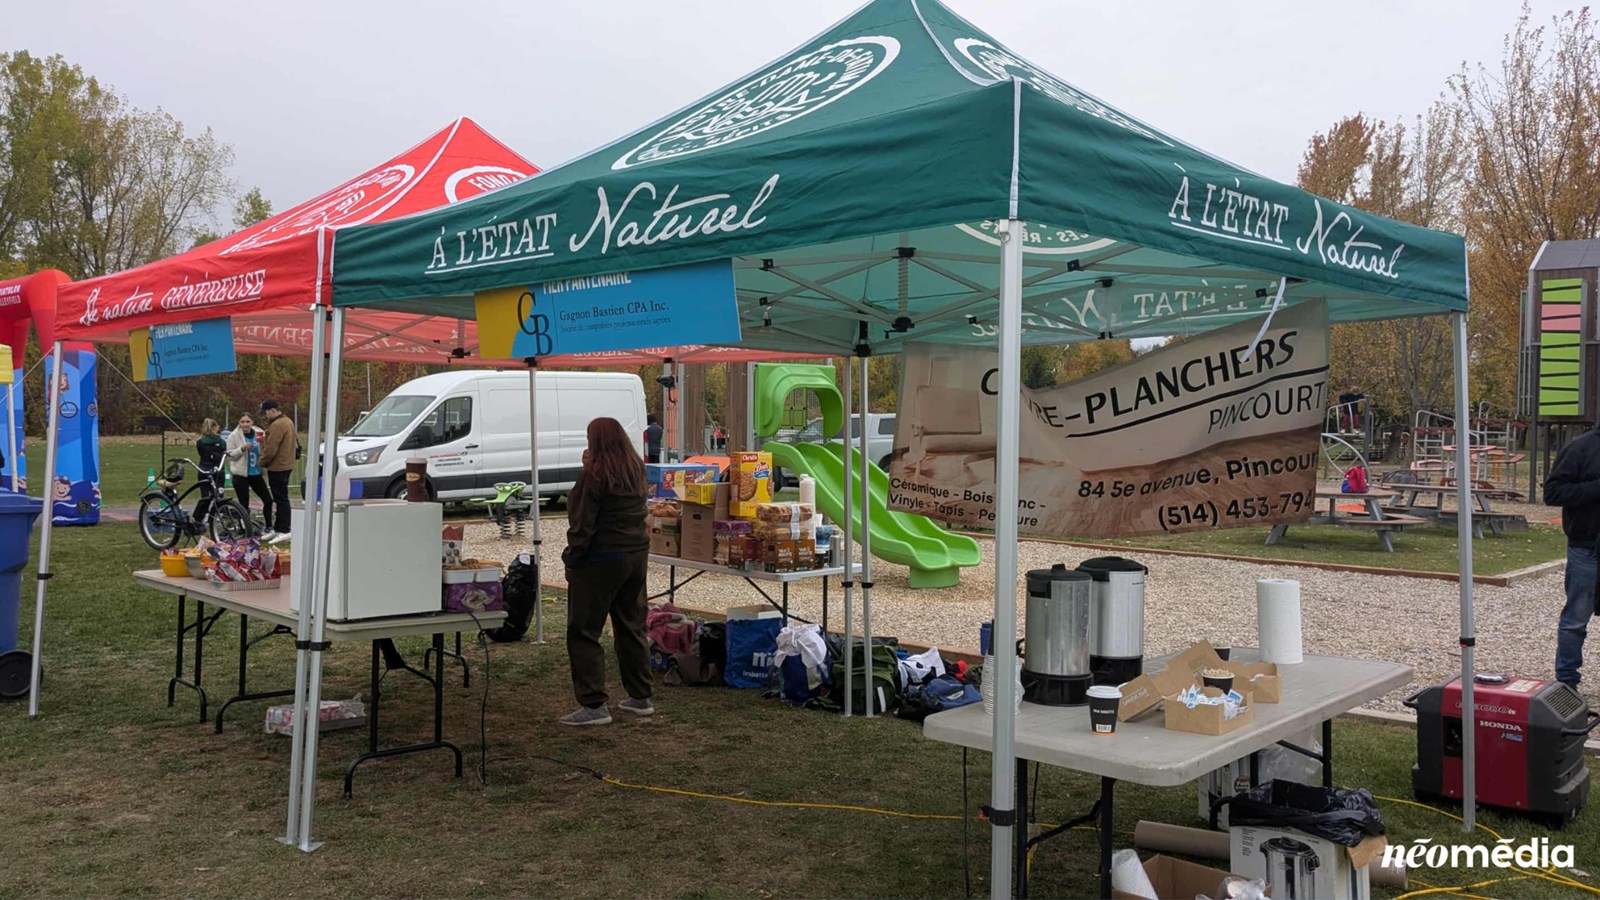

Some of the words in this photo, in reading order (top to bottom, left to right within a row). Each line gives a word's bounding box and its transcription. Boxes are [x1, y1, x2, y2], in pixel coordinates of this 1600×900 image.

[455, 212, 557, 267] L'ÉTAT
[569, 173, 780, 255] Naturel
[1296, 199, 1405, 279] Naturel
[103, 286, 154, 321] nature
[160, 271, 266, 311] GÉNÉREUSE
[559, 309, 591, 322] Gagnon
[592, 304, 625, 318] Bastien
[627, 301, 648, 314] CPA
[650, 299, 670, 312] Inc.
[1208, 381, 1325, 434] PINCOURT
[891, 477, 950, 499] Céramique
[963, 489, 993, 504] Bois
[1078, 480, 1105, 498] 84
[1111, 481, 1135, 498] 5e
[1140, 468, 1220, 496] avenue,
[890, 493, 924, 509] Vinyle
[934, 500, 965, 518] Tapis
[1158, 500, 1218, 531] (514)
[1479, 720, 1523, 732] HONDA
